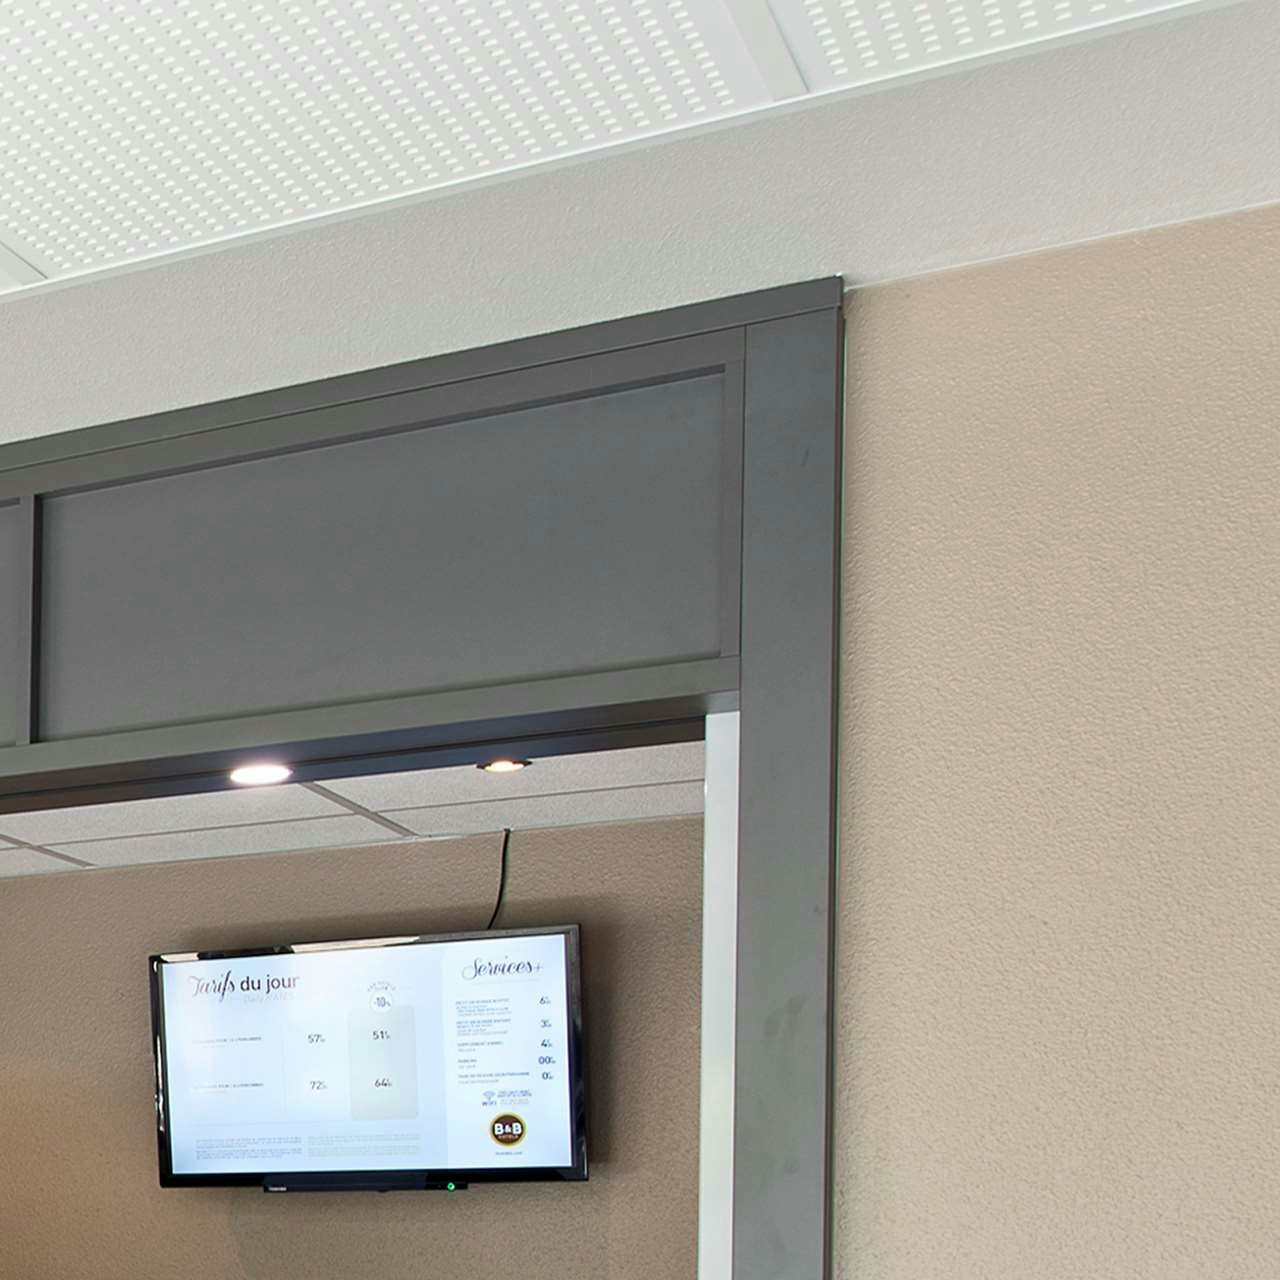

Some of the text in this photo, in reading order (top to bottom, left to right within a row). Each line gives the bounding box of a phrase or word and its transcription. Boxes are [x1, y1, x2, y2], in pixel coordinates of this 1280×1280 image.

[240, 975, 261, 991] du
[266, 974, 300, 994] jour
[494, 1122, 522, 1135] B&B
